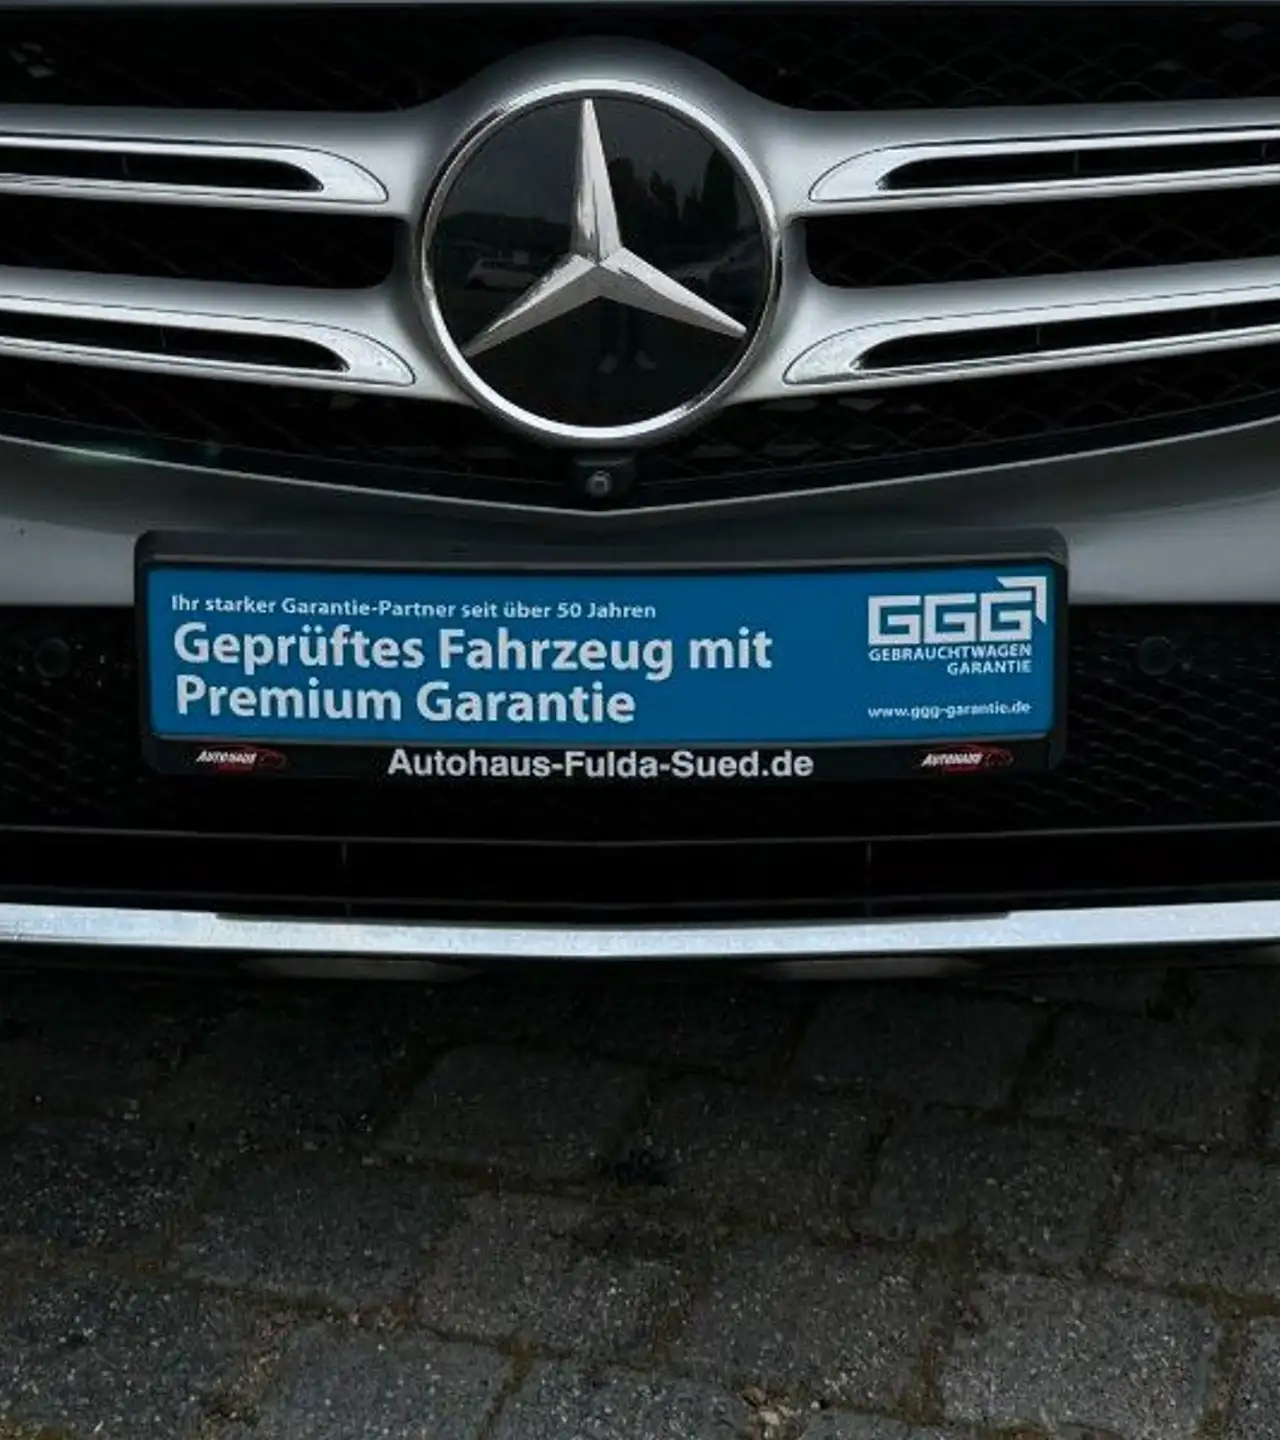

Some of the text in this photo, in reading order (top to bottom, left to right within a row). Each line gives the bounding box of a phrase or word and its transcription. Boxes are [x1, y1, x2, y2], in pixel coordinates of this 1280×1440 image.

[172, 595, 657, 618] Ihr starker Garantie-Partner seit über 50 Jahren
[868, 591, 1032, 645] GGG
[174, 621, 773, 681] Geprüftes Fahrzeug mit
[868, 644, 1032, 662] GEBRAUCHTWAGEN
[946, 660, 1032, 676] GARANTIE
[176, 674, 636, 723] Premium Garantie
[868, 701, 1032, 720] www.ggg-garantie.de
[387, 748, 816, 778] Autohaus-Fulda-Sued.de
